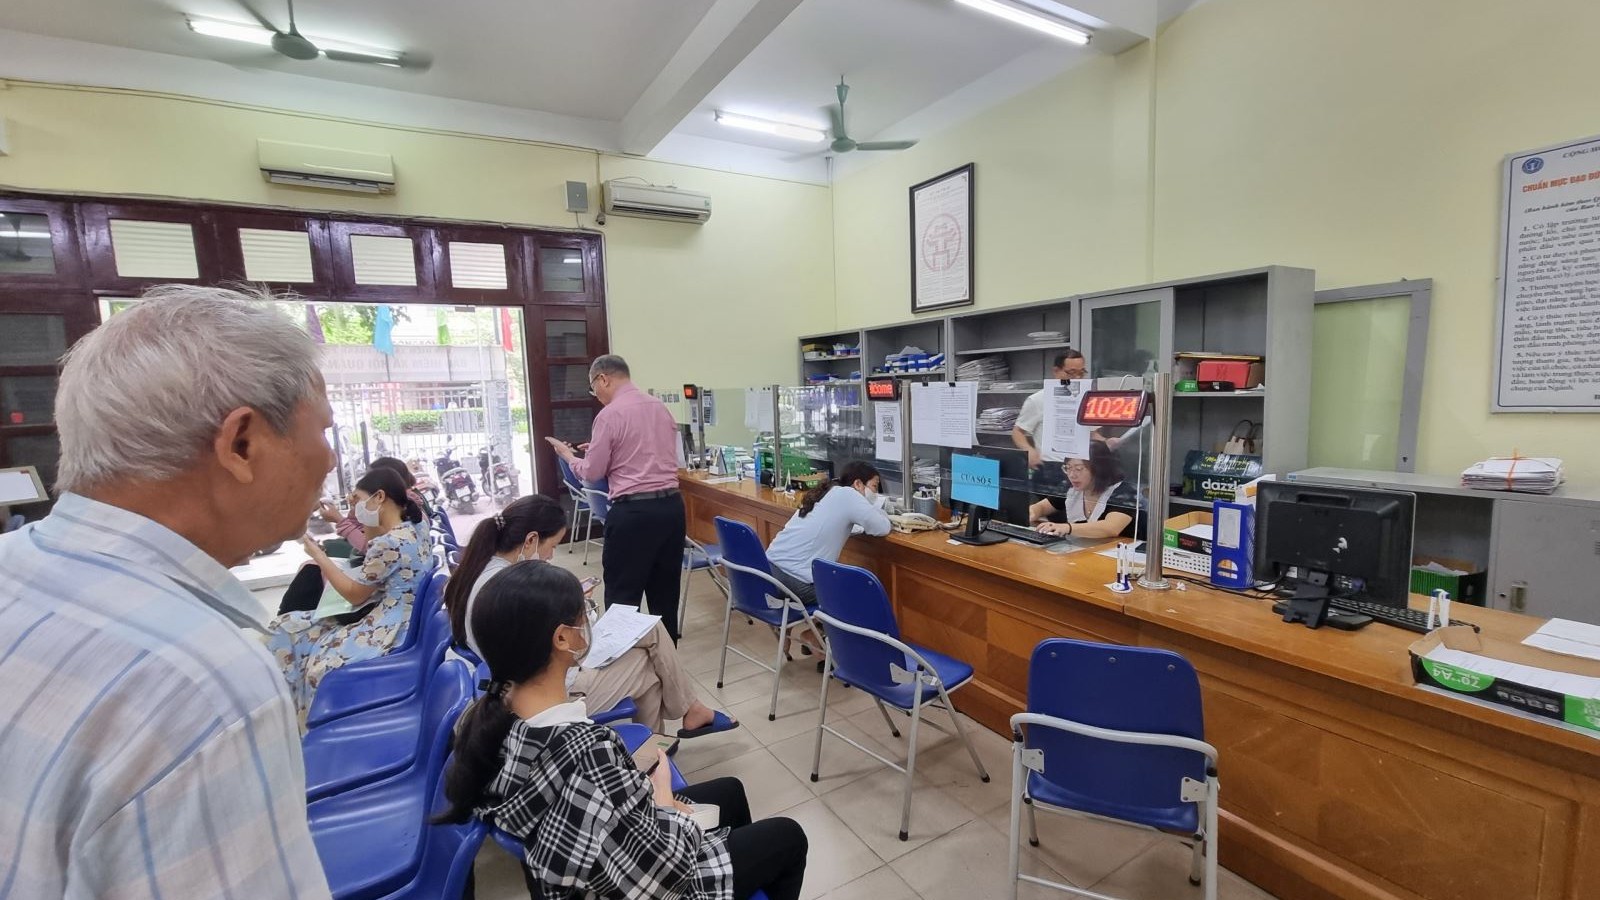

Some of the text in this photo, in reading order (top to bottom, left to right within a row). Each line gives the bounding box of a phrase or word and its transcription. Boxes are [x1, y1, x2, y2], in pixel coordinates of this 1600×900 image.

[1522, 180, 1548, 192] CHUẨN
[1084, 397, 1139, 419] 1024
[1433, 669, 1454, 682] A4
